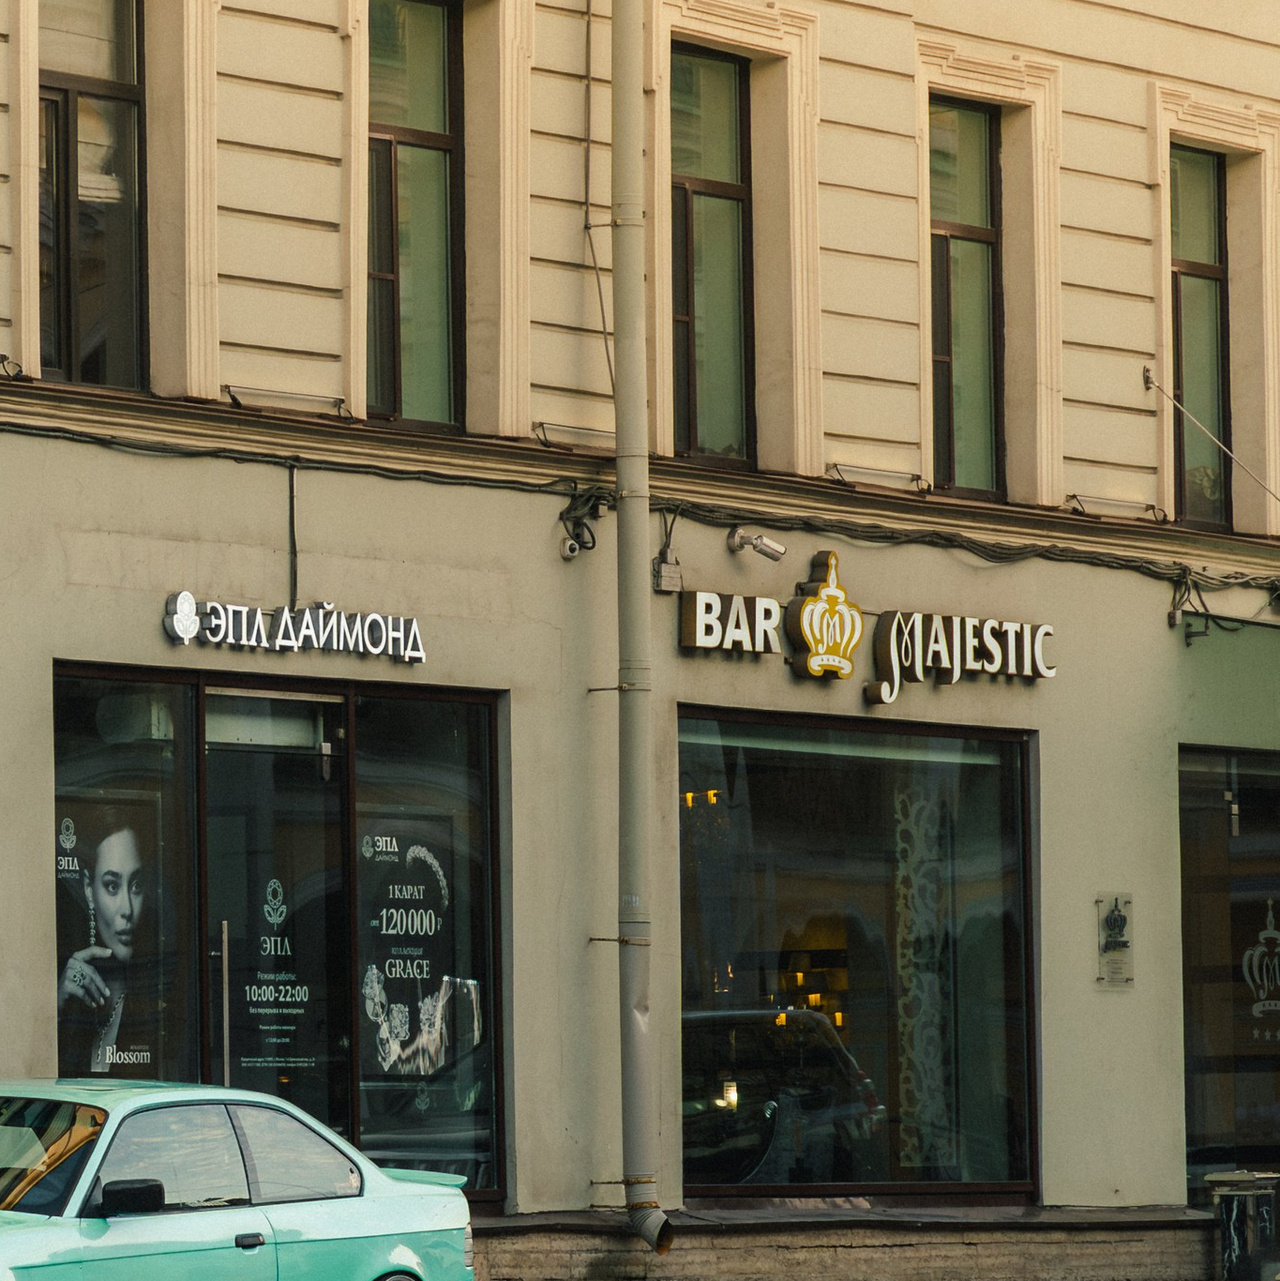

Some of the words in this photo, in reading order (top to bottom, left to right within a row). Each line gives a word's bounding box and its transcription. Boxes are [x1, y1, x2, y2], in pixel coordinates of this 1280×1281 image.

[205, 601, 269, 648] ЭПЛ
[275, 601, 426, 663] ДАЙМОНД
[694, 591, 782, 654] BAR
[880, 610, 1057, 705] MAJESTIC
[374, 836, 399, 852] ЭПЛ
[57, 856, 80, 871] ЭПЛ
[394, 885, 425, 899] КАРАТ
[260, 936, 291, 956] ЭПЛ
[385, 958, 430, 979] GRACE
[244, 984, 309, 1002] 10:00-22:00
[104, 1044, 151, 1065] Blossom
